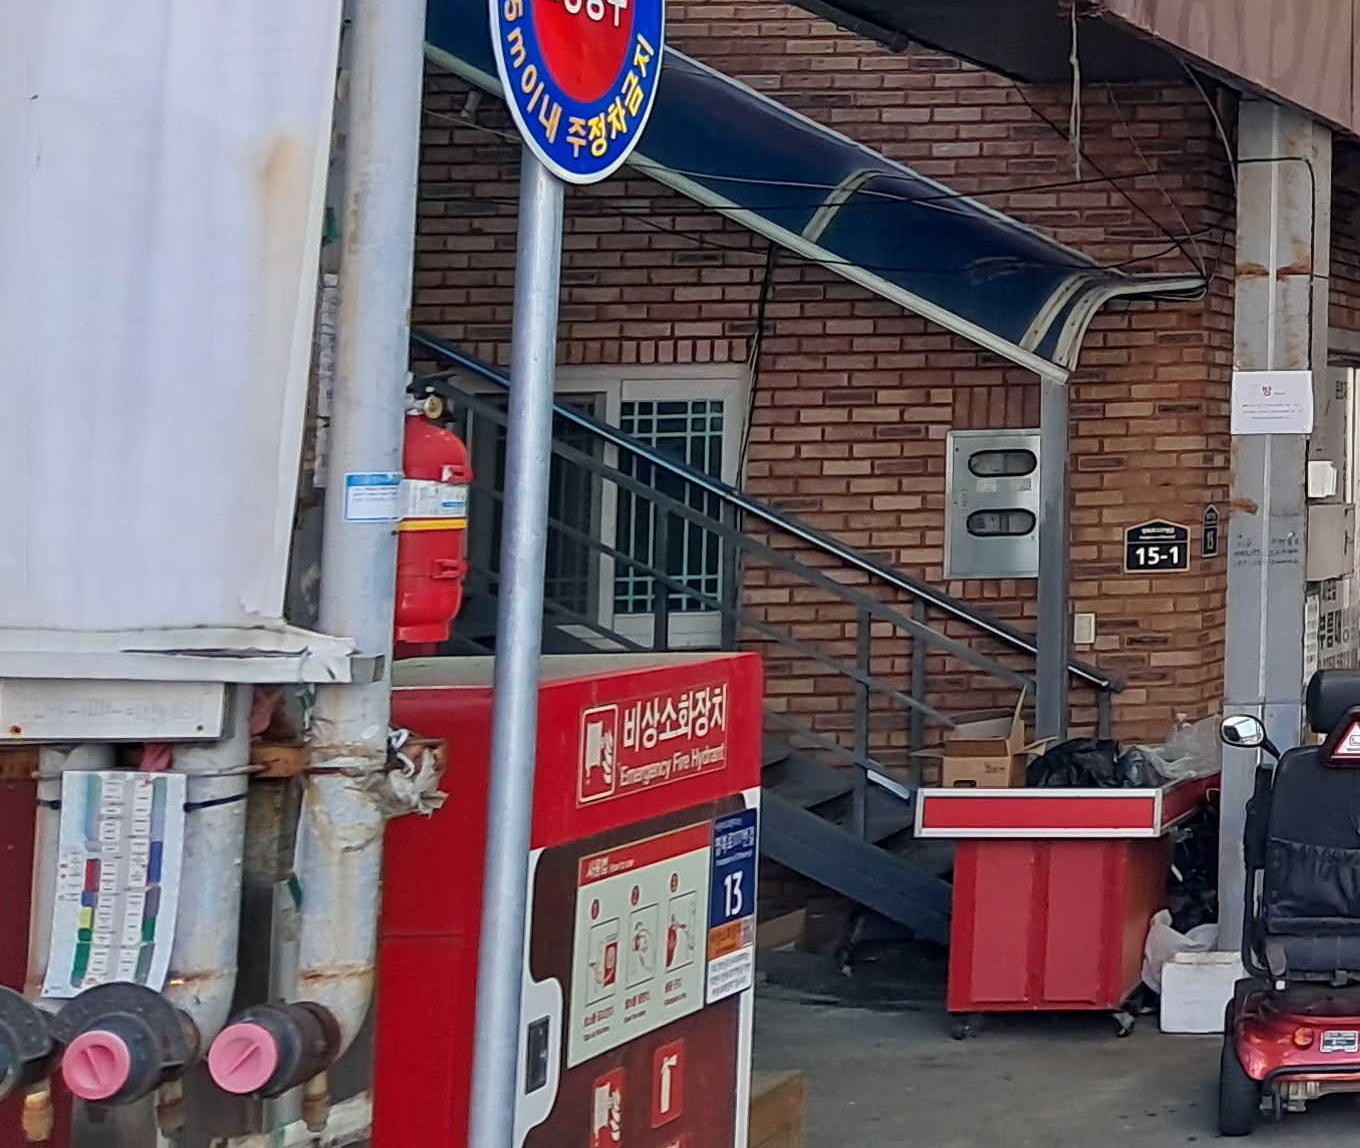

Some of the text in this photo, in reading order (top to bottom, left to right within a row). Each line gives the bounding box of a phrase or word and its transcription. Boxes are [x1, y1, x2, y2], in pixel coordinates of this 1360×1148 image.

[566, 33, 655, 158] 주정차금지
[1135, 546, 1179, 566] 15-1
[623, 683, 728, 752] 비상소화장치
[620, 743, 725, 787] Emergency Fire Hydrant
[723, 870, 744, 917] 13
